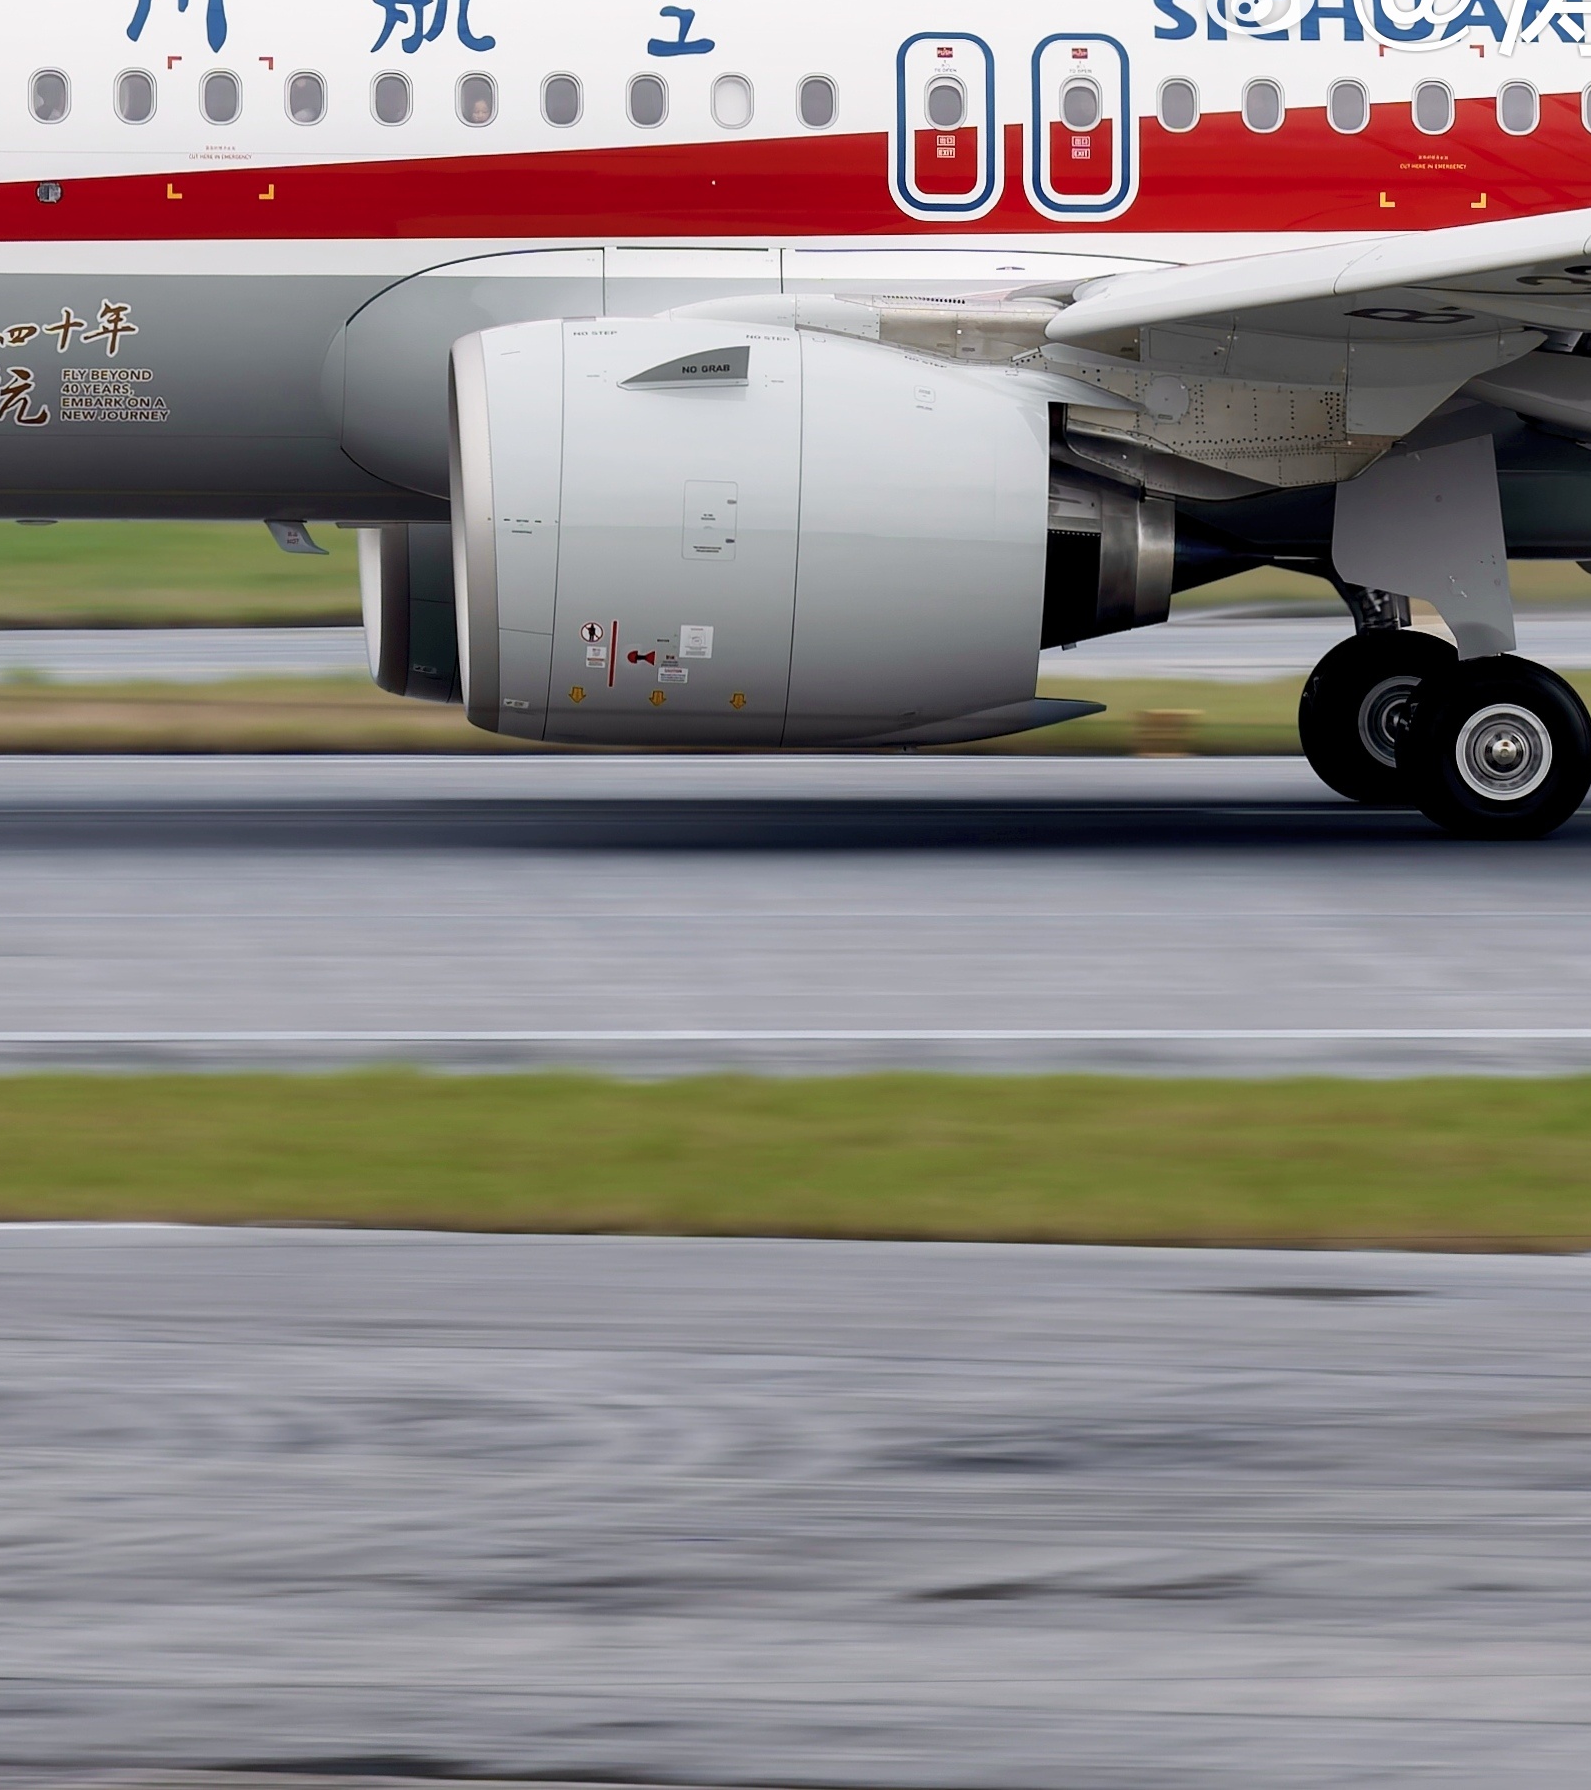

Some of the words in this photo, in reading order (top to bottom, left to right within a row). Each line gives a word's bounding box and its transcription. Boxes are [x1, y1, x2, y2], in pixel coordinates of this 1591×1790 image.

[682, 366, 697, 374] NO
[701, 364, 730, 373] GRAB
[62, 370, 86, 380] FLY
[91, 370, 152, 380] BEYOND
[62, 384, 79, 393] 40
[82, 384, 134, 395] YEARS,
[62, 398, 123, 407] EMBARK
[127, 398, 150, 407] ON
[154, 398, 165, 407] A
[61, 411, 96, 420] NEW
[99, 411, 169, 420] JOURNEY
